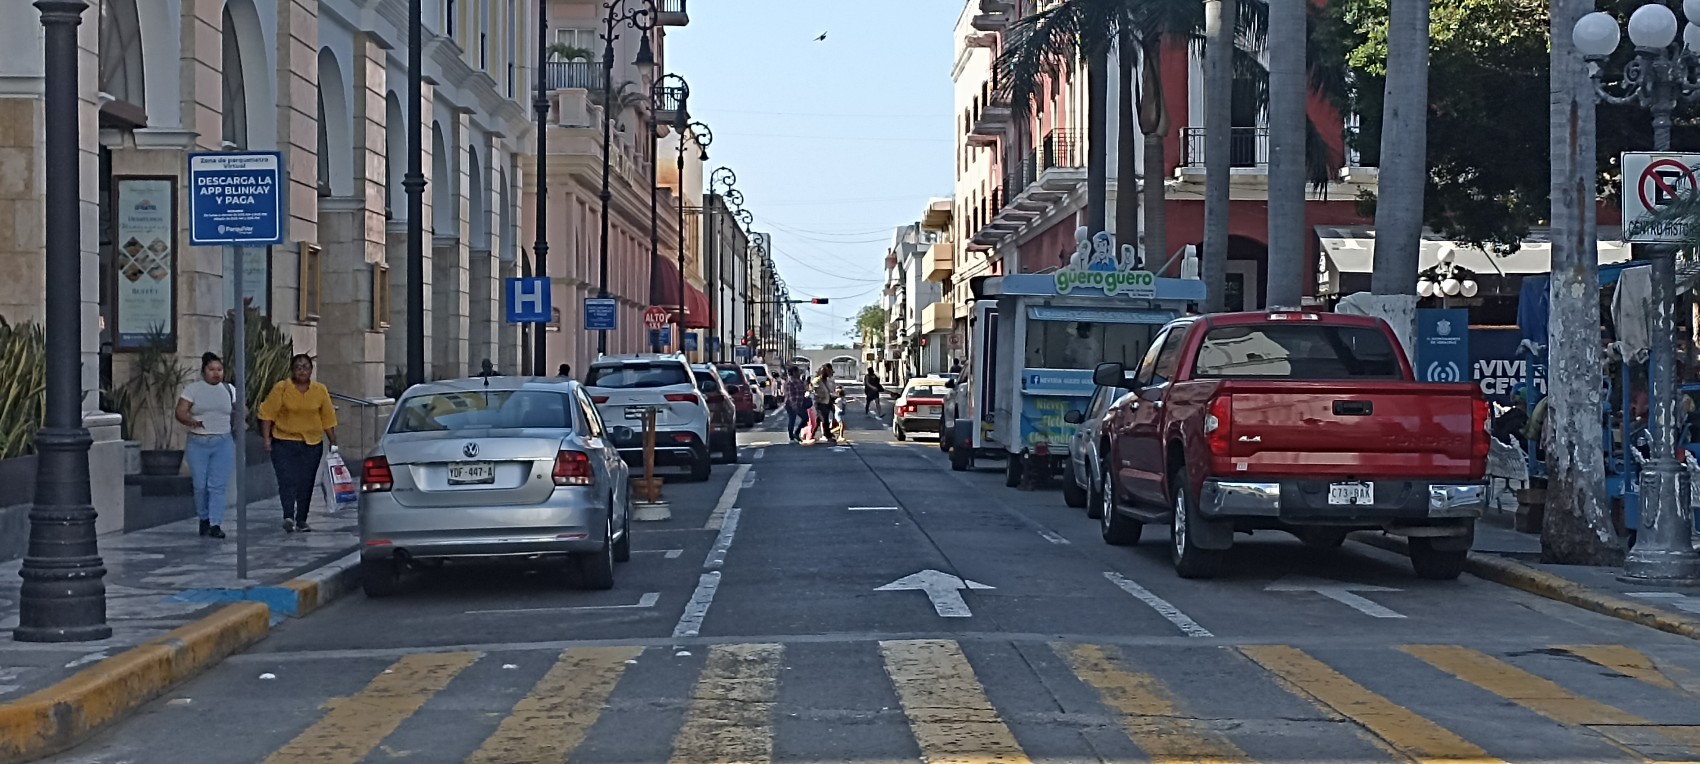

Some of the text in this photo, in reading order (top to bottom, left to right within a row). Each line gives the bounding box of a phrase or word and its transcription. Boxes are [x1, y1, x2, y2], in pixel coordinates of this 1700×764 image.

[198, 176, 273, 186] DESCARGA LA
[200, 185, 271, 195] APP BLINKAY
[215, 195, 256, 205] Y PAGA
[514, 280, 543, 314] H
[645, 313, 665, 323] ALTO
